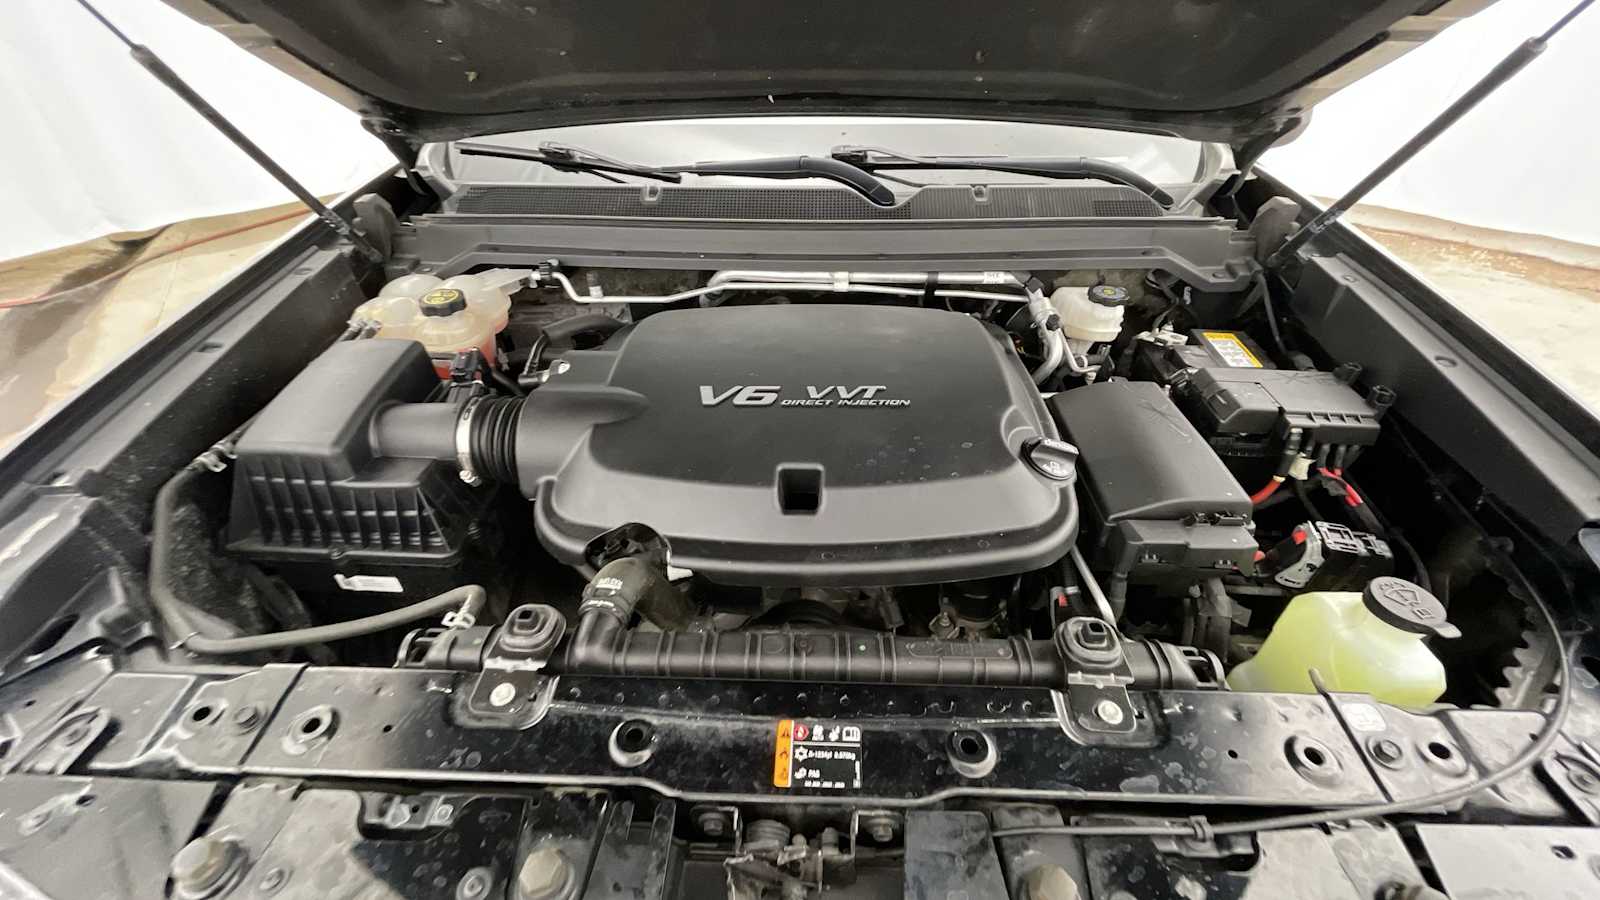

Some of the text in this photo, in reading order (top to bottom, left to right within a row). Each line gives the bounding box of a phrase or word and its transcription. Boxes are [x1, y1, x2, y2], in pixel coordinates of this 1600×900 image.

[700, 385, 887, 407] V6 VVT
[780, 399, 911, 407] DIRECT INJECTION
